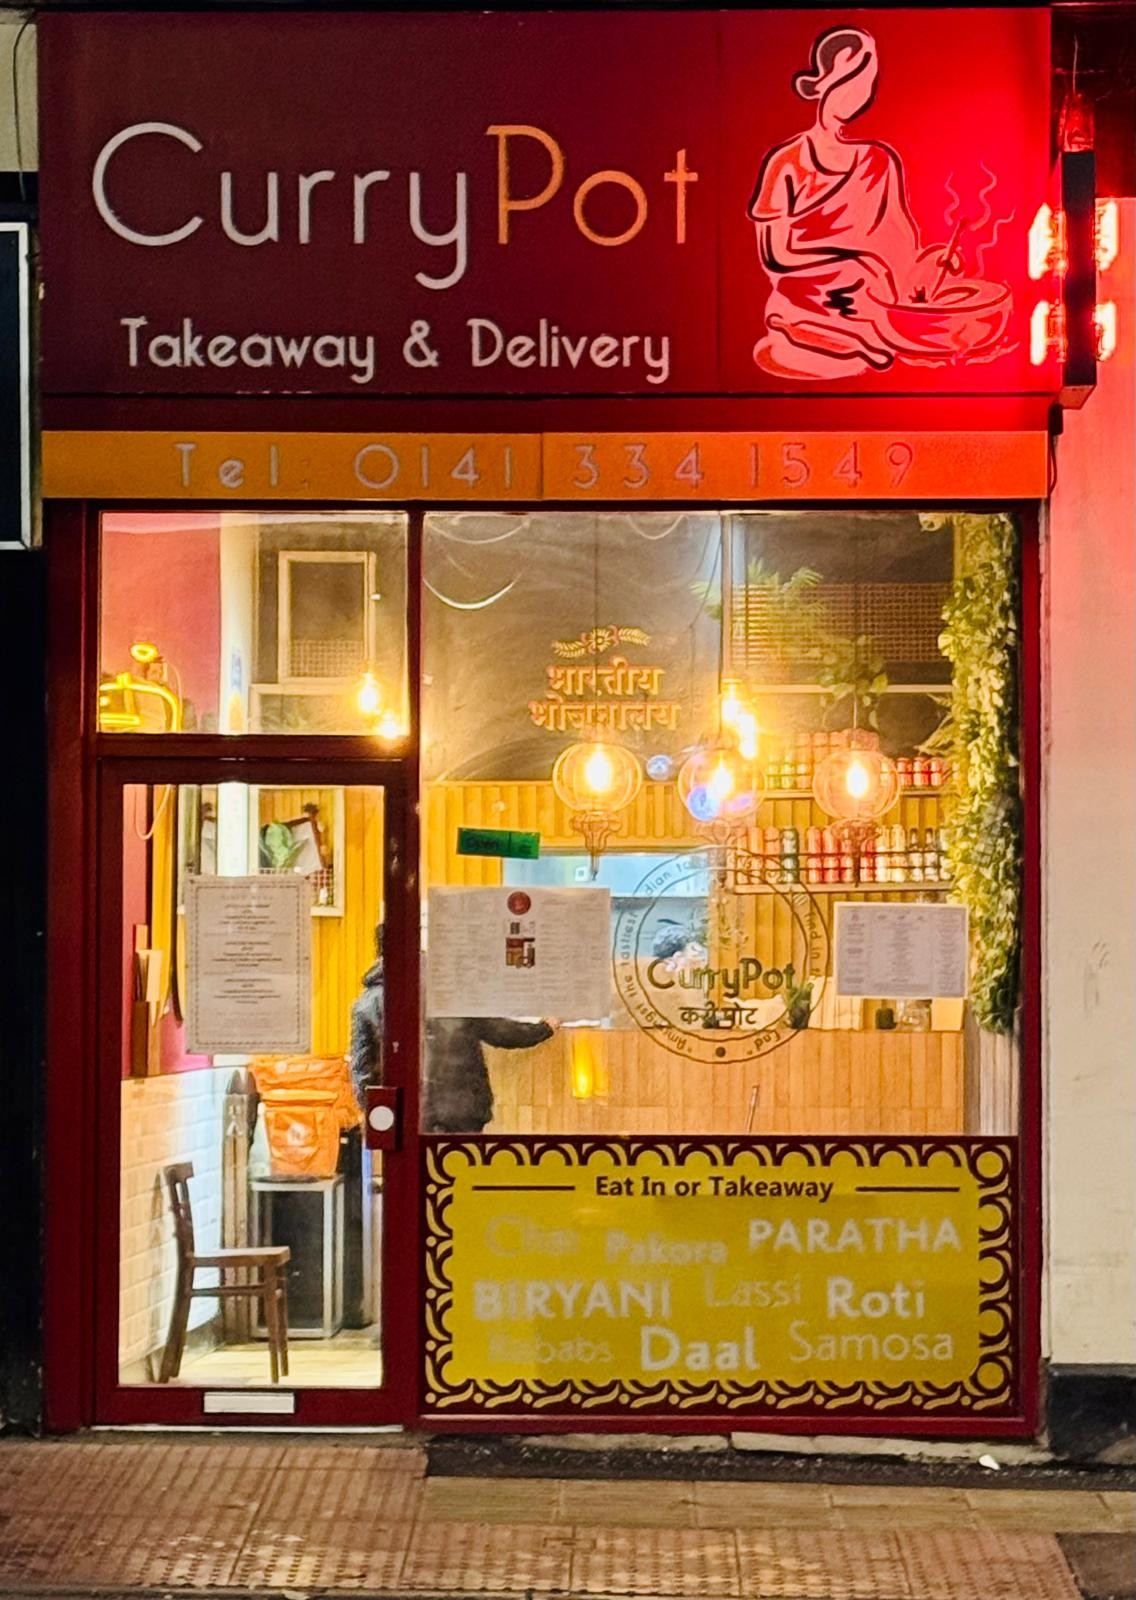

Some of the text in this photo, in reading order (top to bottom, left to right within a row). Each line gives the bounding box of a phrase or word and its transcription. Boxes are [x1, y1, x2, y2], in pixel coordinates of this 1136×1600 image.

[92, 121, 699, 289] CurryPot
[121, 316, 670, 384] Takeaway & Delivery
[354, 443, 513, 489] 0141
[572, 444, 705, 489] 334
[751, 442, 914, 489] 1549
[595, 1174, 834, 1203] Eat In or Takeaway
[604, 1227, 729, 1265] Pakora
[749, 1215, 962, 1254] PARATHA
[473, 1278, 674, 1321] BIRYANI
[704, 1264, 803, 1308] Lassi
[827, 1275, 926, 1321] Roti
[641, 1323, 761, 1372] Daal
[790, 1320, 955, 1362] Samosa
